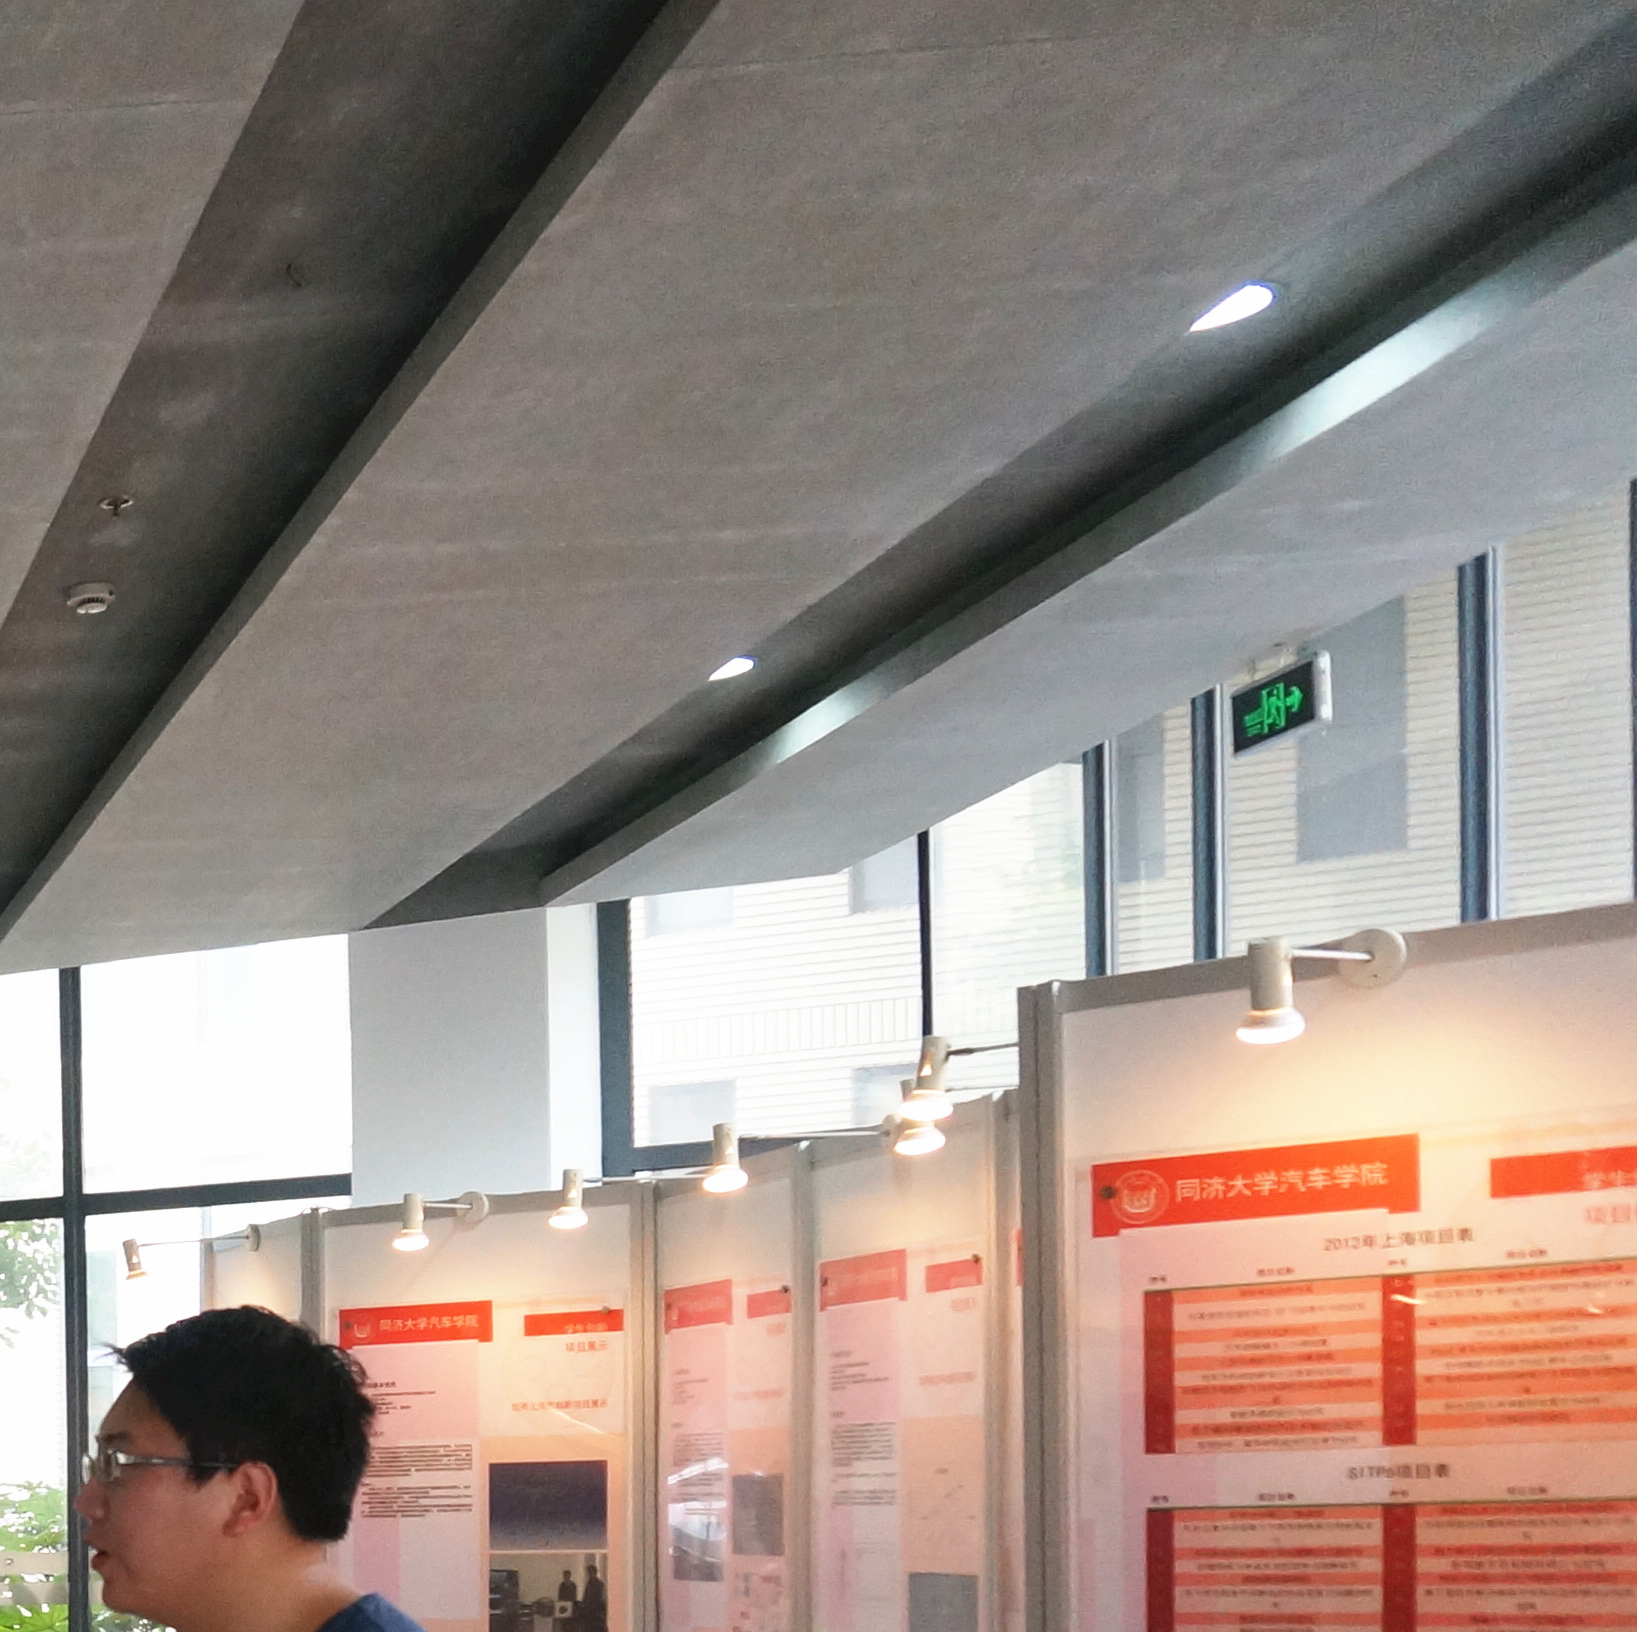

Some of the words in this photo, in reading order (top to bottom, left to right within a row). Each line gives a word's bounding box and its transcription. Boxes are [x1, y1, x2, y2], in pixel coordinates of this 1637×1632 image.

[1176, 1161, 1389, 1202] 同济大学汽车学院
[379, 1315, 479, 1333] 同济大学汽车学院
